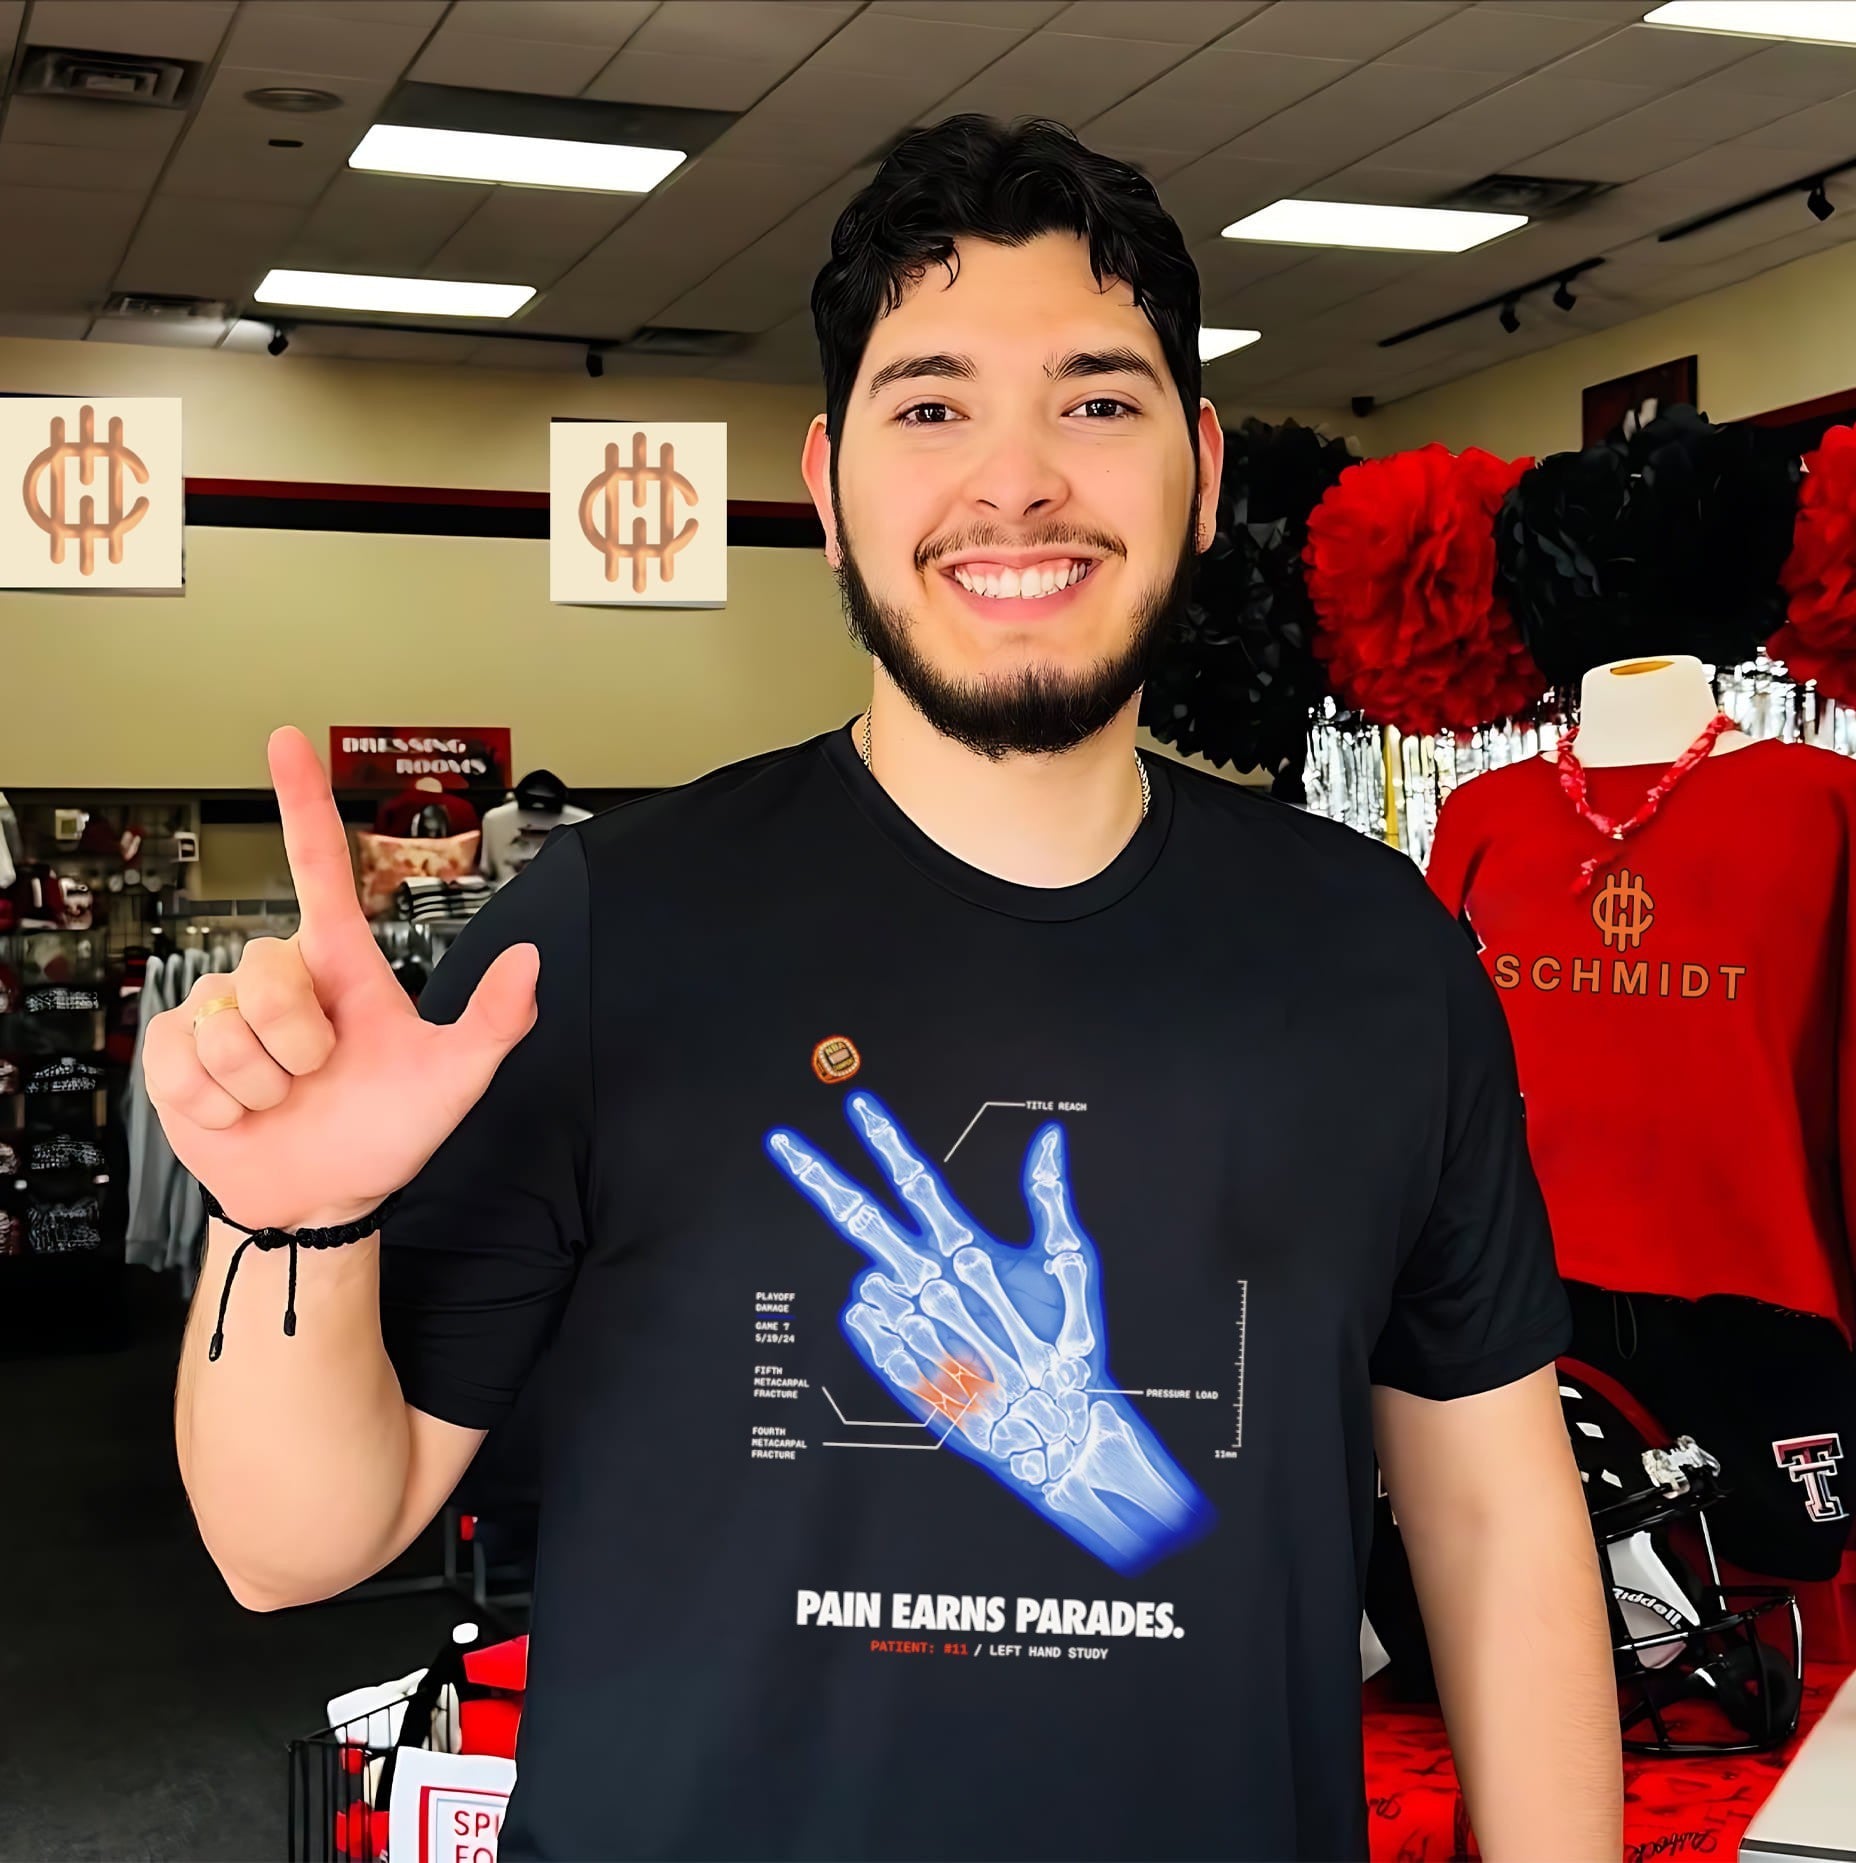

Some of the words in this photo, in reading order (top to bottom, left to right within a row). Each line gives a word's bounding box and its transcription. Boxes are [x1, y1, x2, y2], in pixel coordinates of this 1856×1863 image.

[396, 758, 487, 775] ROOMS
[1494, 953, 1747, 1000] SCHMIDT
[1026, 1100, 1054, 1111] TITLE
[1057, 1101, 1088, 1112] REACH
[755, 1291, 796, 1302] PLAYOFF
[755, 1303, 790, 1313] DAMAGE
[755, 1321, 779, 1331] GAME
[782, 1322, 791, 1331] 7
[755, 1333, 796, 1344] 5/19/24
[754, 1365, 783, 1375] FIFTH
[753, 1377, 810, 1389] METACARPAL
[753, 1388, 799, 1399] FRACTURE
[1146, 1388, 1191, 1399] PRESSURE
[1195, 1390, 1219, 1400] LOAD
[752, 1426, 787, 1436] FOURTH
[751, 1438, 808, 1450] METACARPAL
[751, 1449, 796, 1460] FRACTURE
[796, 1589, 882, 1629] PAIN
[891, 1593, 1006, 1633] EARNS
[1015, 1597, 1185, 1639] PARADES.
[870, 1639, 935, 1654] PATIENT:
[943, 1643, 968, 1656] #11
[989, 1645, 1022, 1657] LEFT
[1028, 1646, 1061, 1658] HAND
[1068, 1647, 1109, 1660] STUDY
